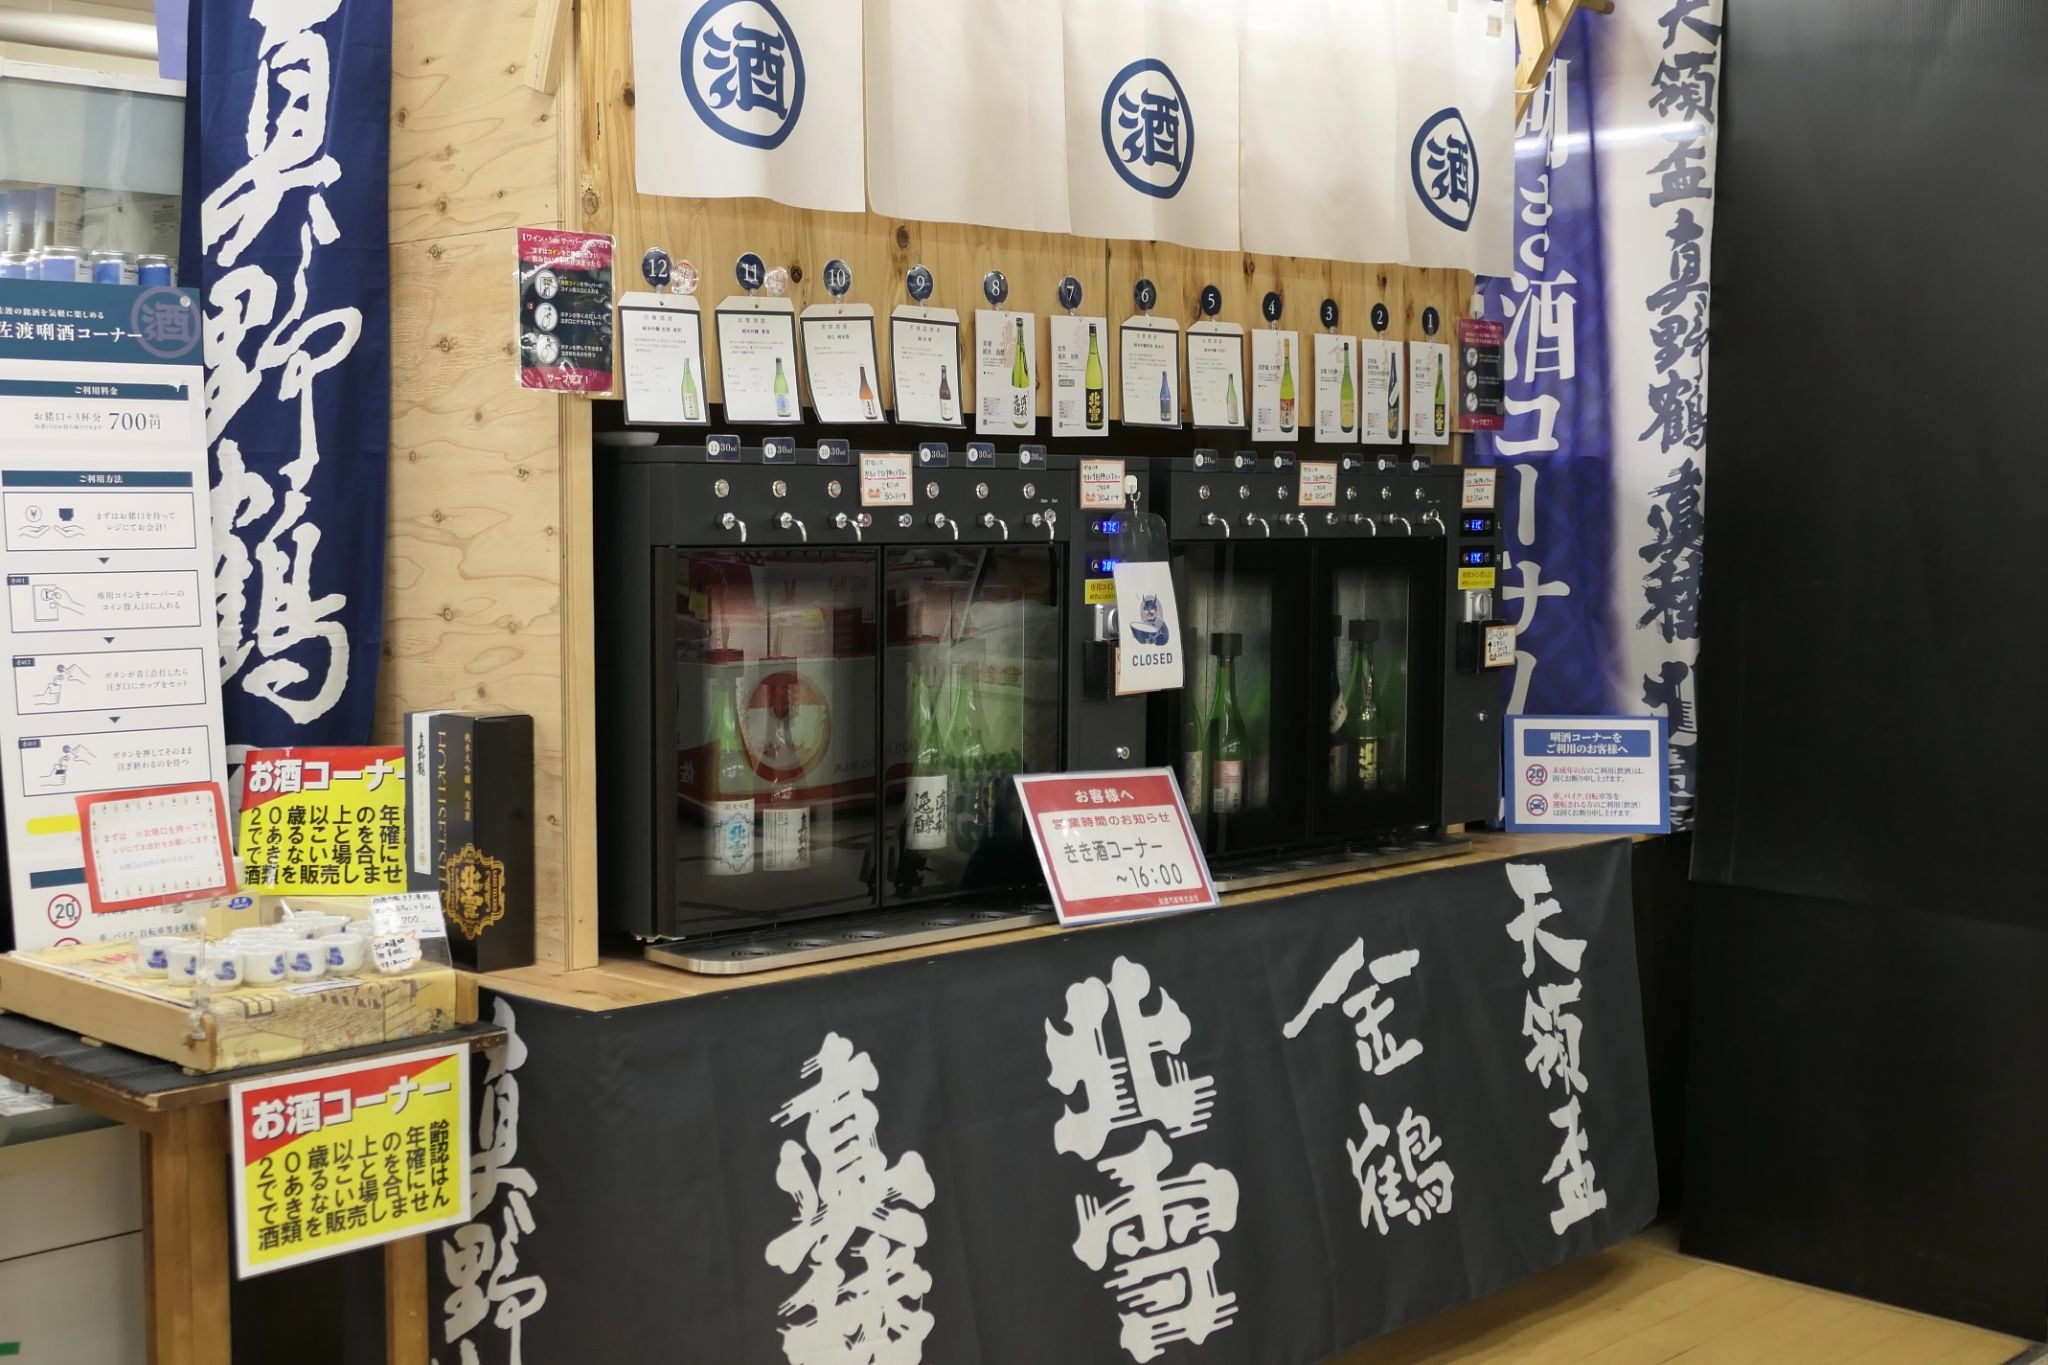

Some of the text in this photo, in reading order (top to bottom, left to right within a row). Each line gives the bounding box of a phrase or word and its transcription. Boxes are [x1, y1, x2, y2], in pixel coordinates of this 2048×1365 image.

[702, 21, 788, 121] 酒
[1117, 88, 1184, 173] 酒
[1426, 134, 1475, 209] 酒
[648, 258, 668, 278] 12
[828, 269, 846, 287] 10
[916, 275, 925, 292] 9
[991, 279, 1000, 296] 8
[1066, 285, 1075, 301] 7
[1141, 287, 1150, 303] 6
[1208, 293, 1216, 309] 5
[1268, 299, 1275, 315] 4
[1325, 306, 1333, 321] 3
[142, 302, 191, 343] 酒
[1376, 310, 1384, 325] 2
[1428, 313, 1433, 328] 1
[74, 386, 119, 396] ご利用料金
[79, 474, 123, 484] ご利用方法
[1132, 652, 1173, 667] CLOSED
[1546, 743, 1629, 755] ご利用のお客様へ
[250, 758, 405, 794] お酒コーナ
[1074, 788, 1135, 804] お客様へ
[250, 804, 405, 826] 20歳以上の年
[1051, 812, 1171, 830] 営業時間のお知らせ
[247, 825, 406, 846] であることを確
[1063, 837, 1163, 864] きき酒コーナー
[1505, 862, 1607, 1235] 天領盃
[1282, 937, 1455, 1235] 金鶴
[251, 1075, 452, 1142] お酒コーナー
[258, 1119, 450, 1180] 20歳以上の年齢
[1045, 955, 1239, 1364] 北雪
[256, 1141, 450, 1202] であることを確認
[440, 996, 548, 1365] 真野
[257, 1165, 450, 1225] できない場合には
[258, 1187, 450, 1251] 酒類を販売しません
